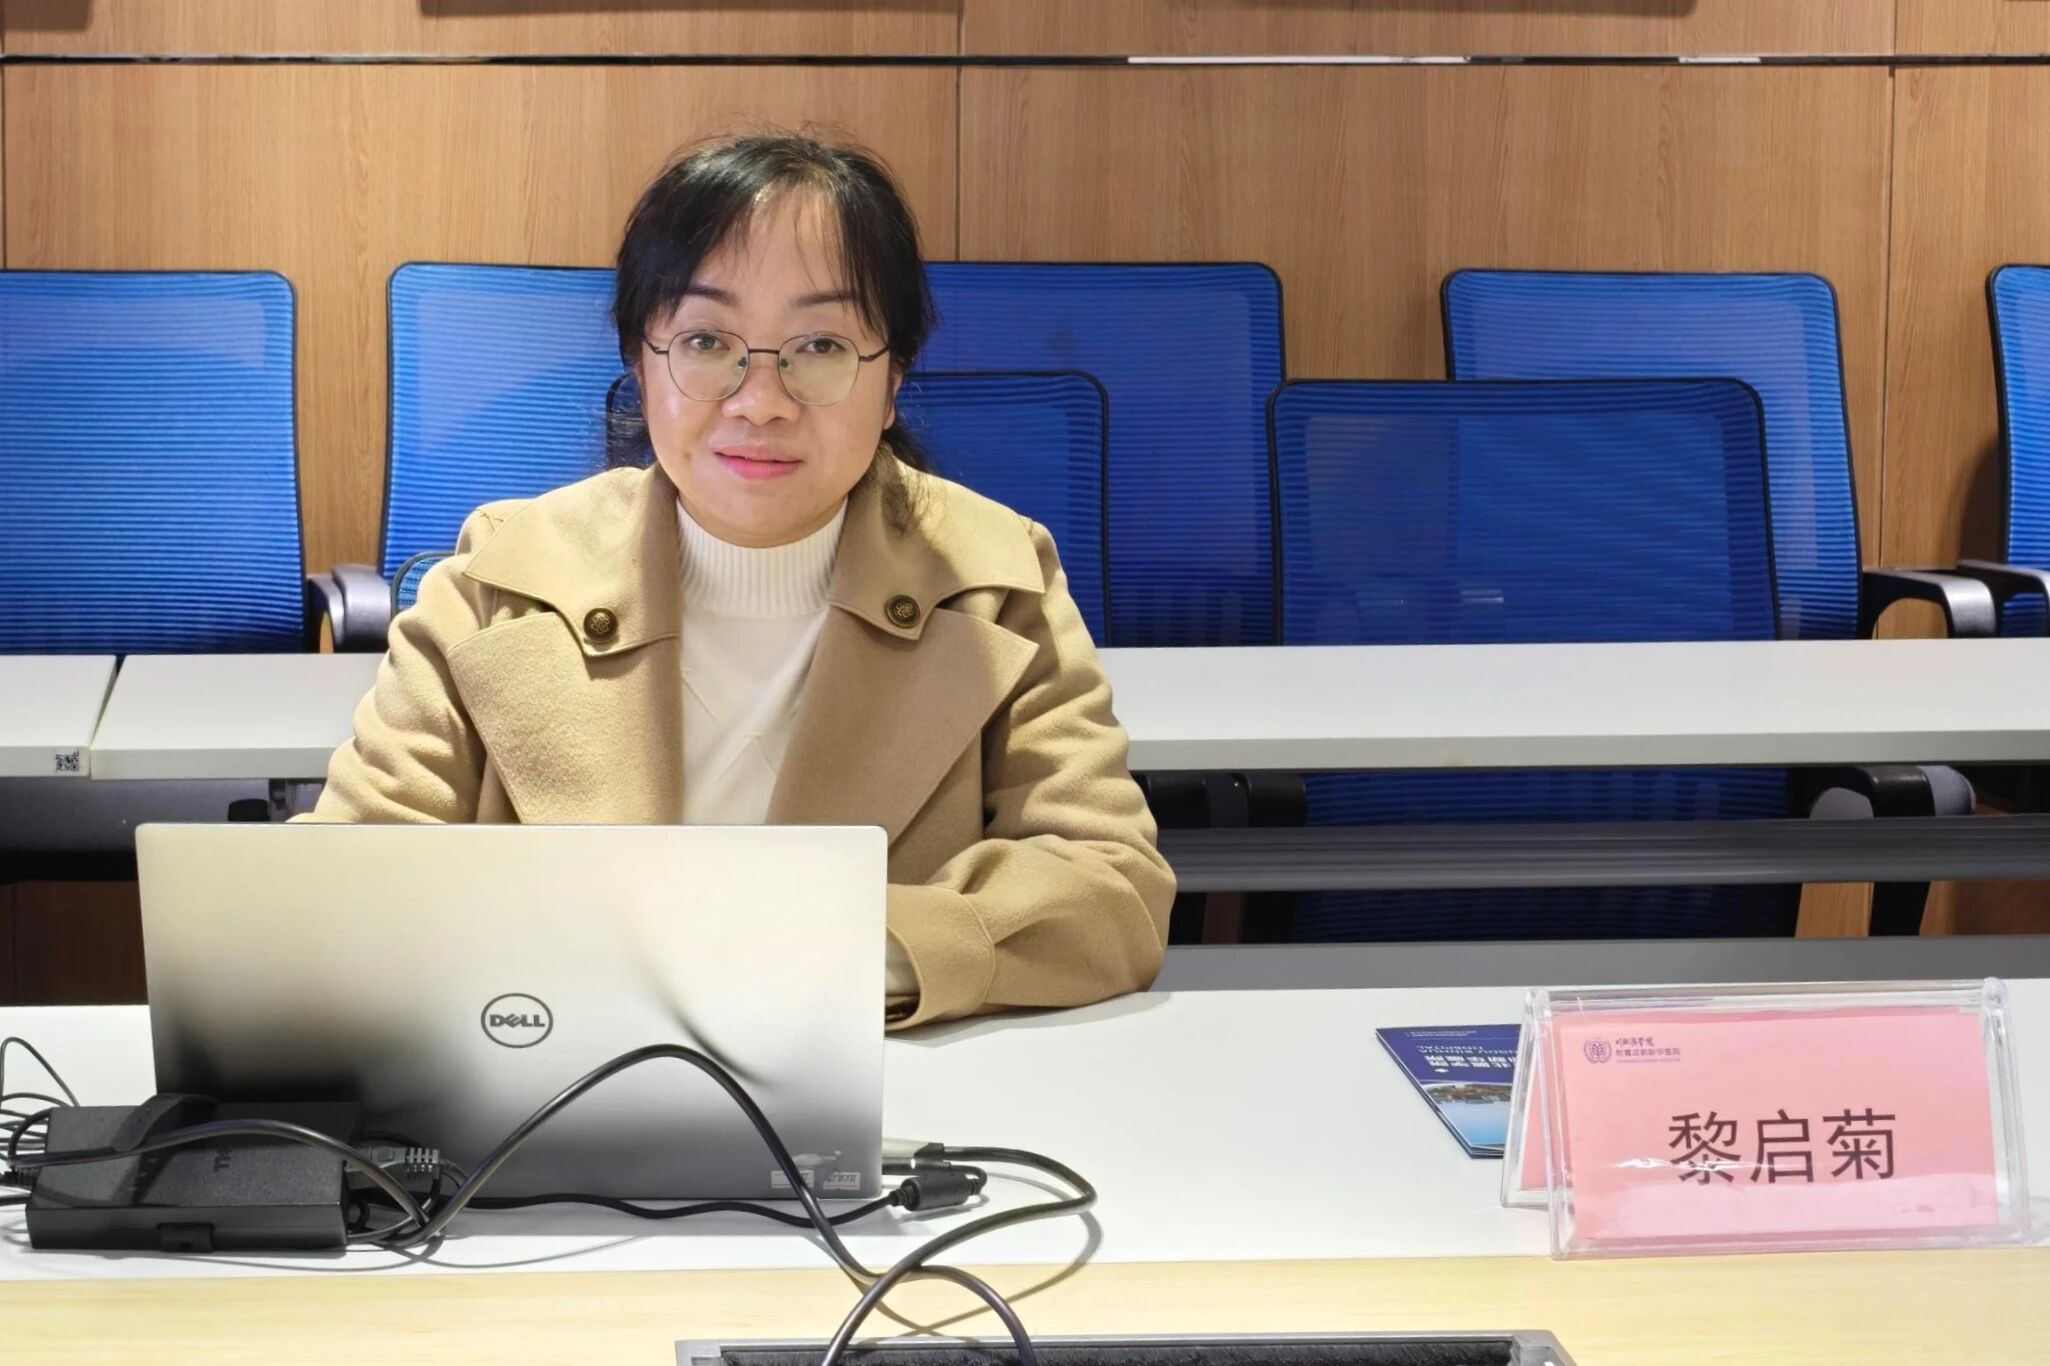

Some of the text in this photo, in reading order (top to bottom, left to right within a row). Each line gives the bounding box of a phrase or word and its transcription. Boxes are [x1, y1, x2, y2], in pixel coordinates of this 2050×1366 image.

[489, 1013, 546, 1028] DELL
[1668, 1108, 1896, 1185] 黎启菊
